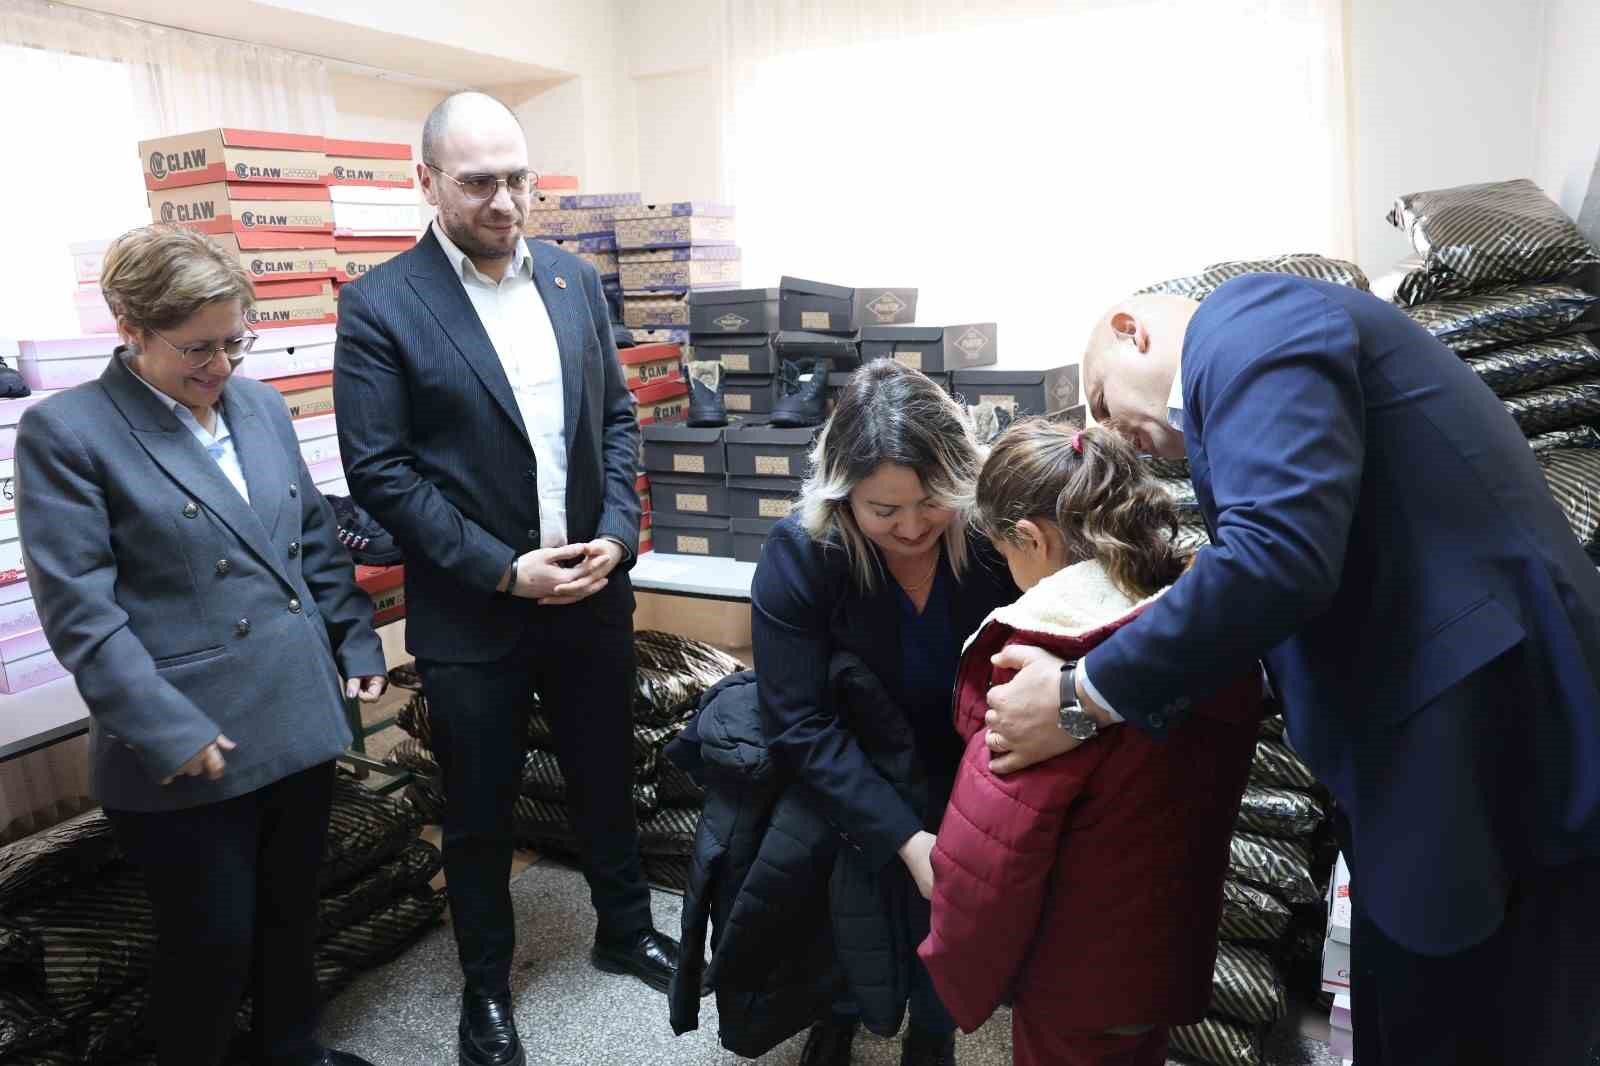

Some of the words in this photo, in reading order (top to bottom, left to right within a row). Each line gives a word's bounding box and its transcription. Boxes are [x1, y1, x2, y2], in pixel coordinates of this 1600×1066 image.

[166, 148, 206, 171] CLAW
[250, 167, 281, 178] CLAW
[346, 169, 374, 180] CLAW
[177, 201, 214, 221] CLAW
[256, 215, 287, 225] CLAW
[265, 261, 294, 272] CLAW
[260, 311, 290, 321] CLAW
[648, 367, 668, 377] CLAW
